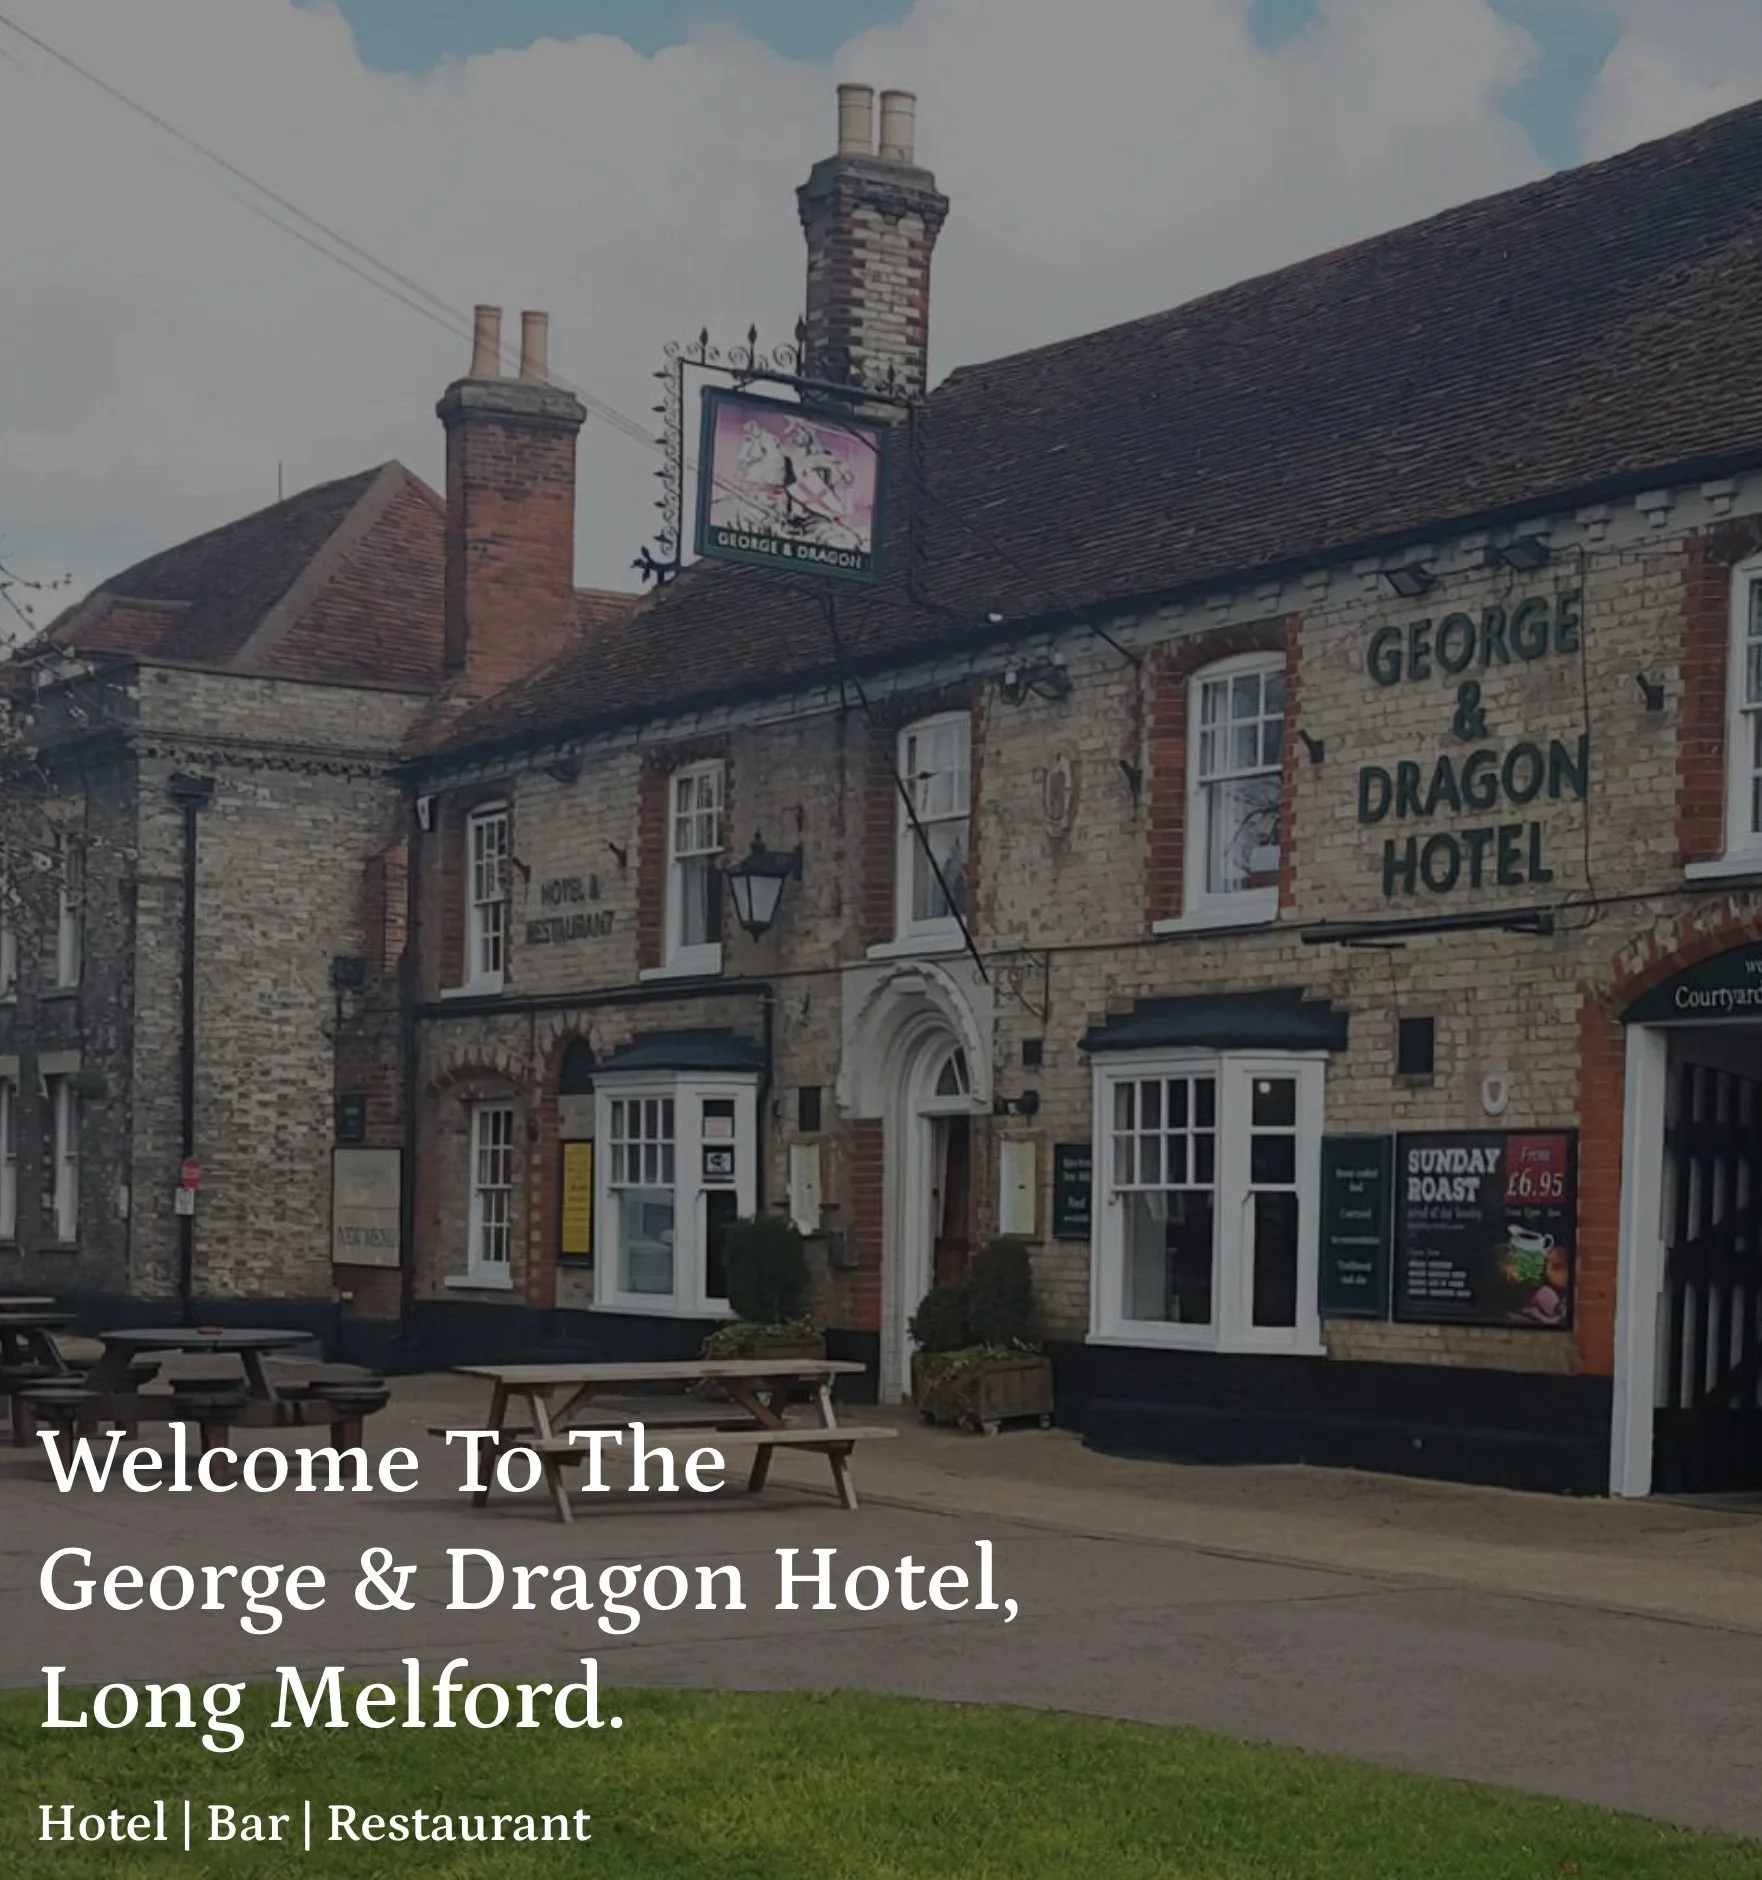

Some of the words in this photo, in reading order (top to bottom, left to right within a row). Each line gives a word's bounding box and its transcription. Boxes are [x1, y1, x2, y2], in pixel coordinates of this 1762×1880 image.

[717, 532, 777, 554] GEORGE
[782, 543, 793, 558] &
[797, 546, 862, 570] DRAGON
[1367, 587, 1581, 687] GEORGE
[1453, 680, 1487, 741] &
[1357, 734, 1588, 824] DRAGON
[1383, 822, 1553, 897] HOTEL
[1408, 1148, 1500, 1174] SUNDAY
[1520, 1146, 1550, 1162] From
[1407, 1176, 1480, 1202] ROAST
[1507, 1168, 1564, 1198] £6.95
